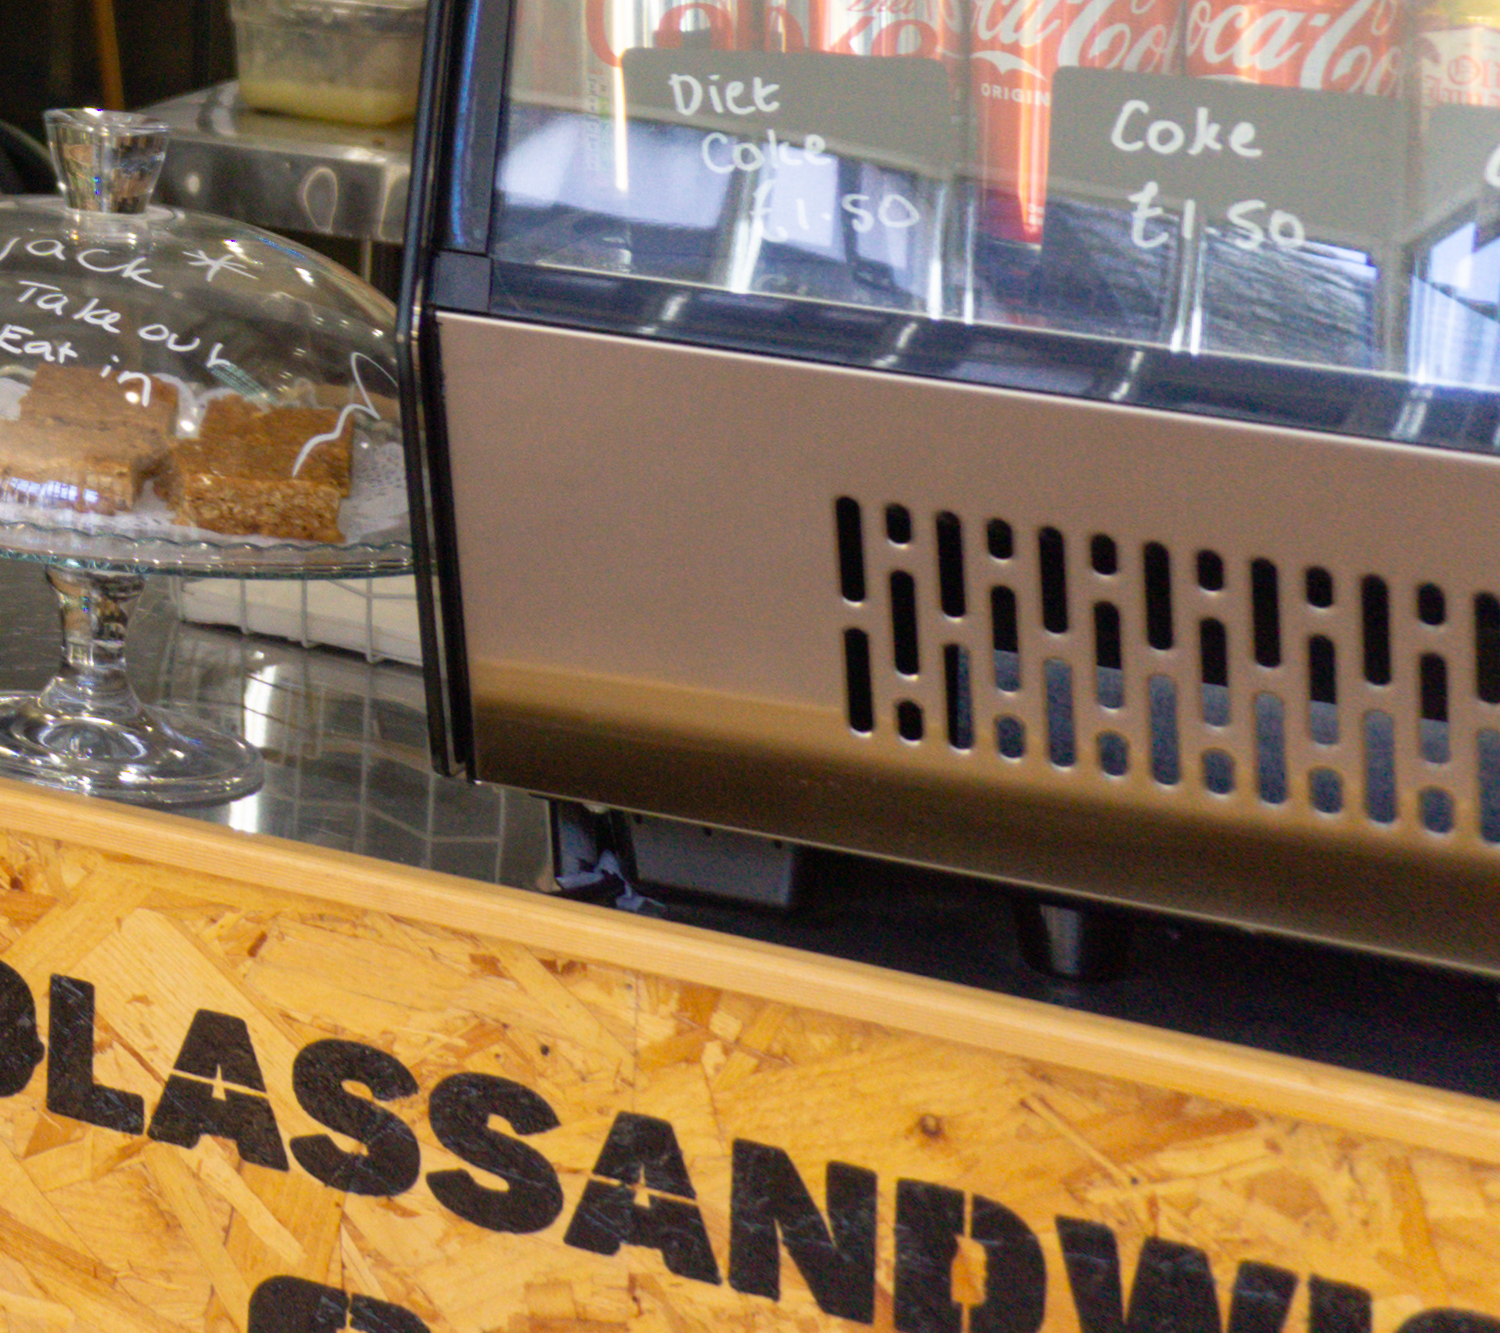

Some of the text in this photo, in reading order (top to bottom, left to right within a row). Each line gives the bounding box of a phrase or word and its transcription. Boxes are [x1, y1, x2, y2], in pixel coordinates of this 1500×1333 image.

[668, 72, 780, 116] Diet
[701, 127, 832, 174] Coke
[1110, 99, 1263, 158] Coke
[17, 279, 122, 334] Take
[138, 323, 230, 368] out
[99, 353, 152, 407] in
